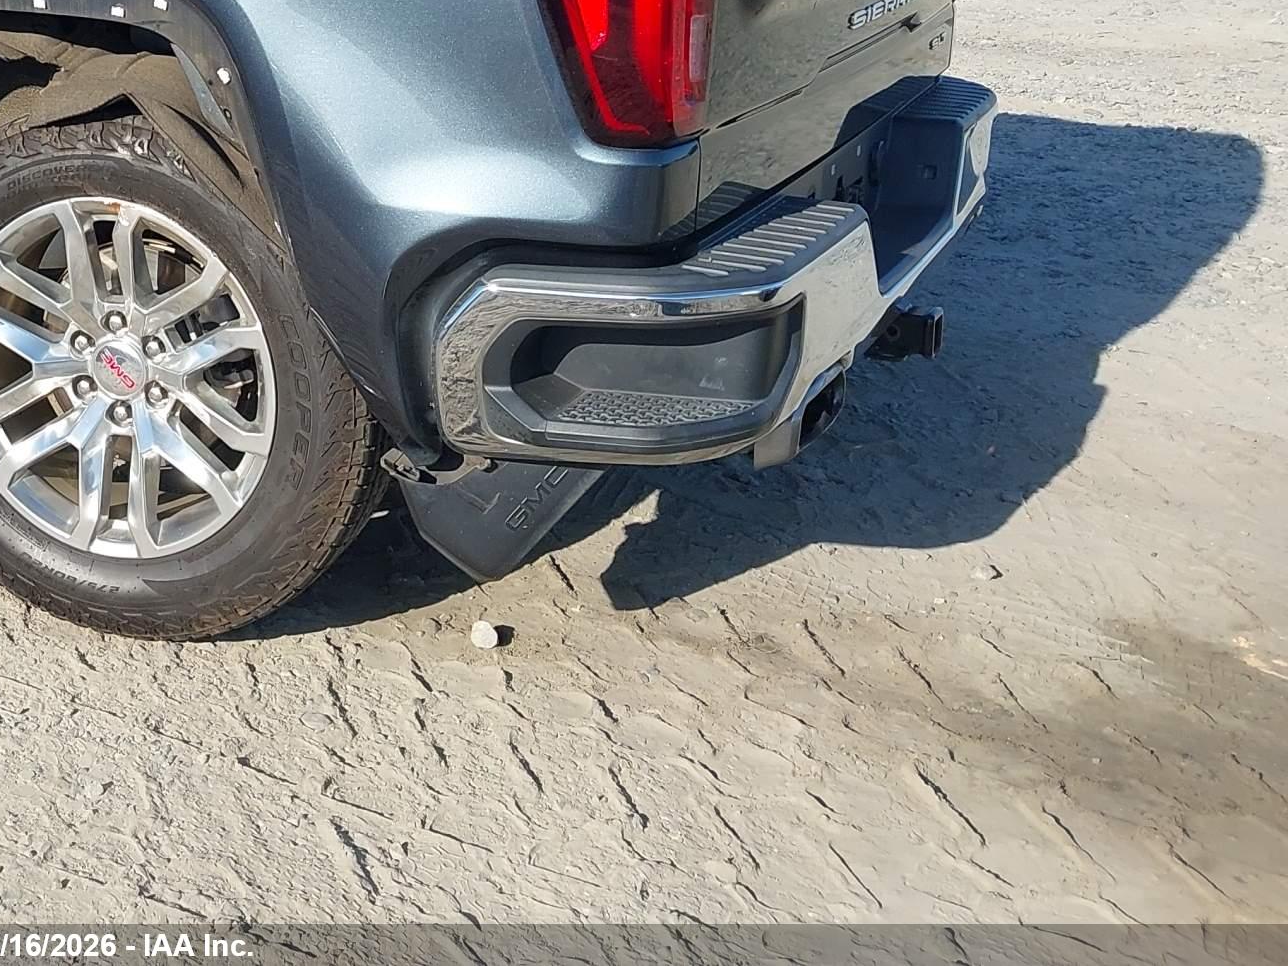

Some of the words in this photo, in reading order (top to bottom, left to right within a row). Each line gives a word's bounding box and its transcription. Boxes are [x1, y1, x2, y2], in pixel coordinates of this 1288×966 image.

[99, 347, 136, 389] GMC
[278, 314, 312, 491] COOPER
[505, 465, 569, 530] GMC
